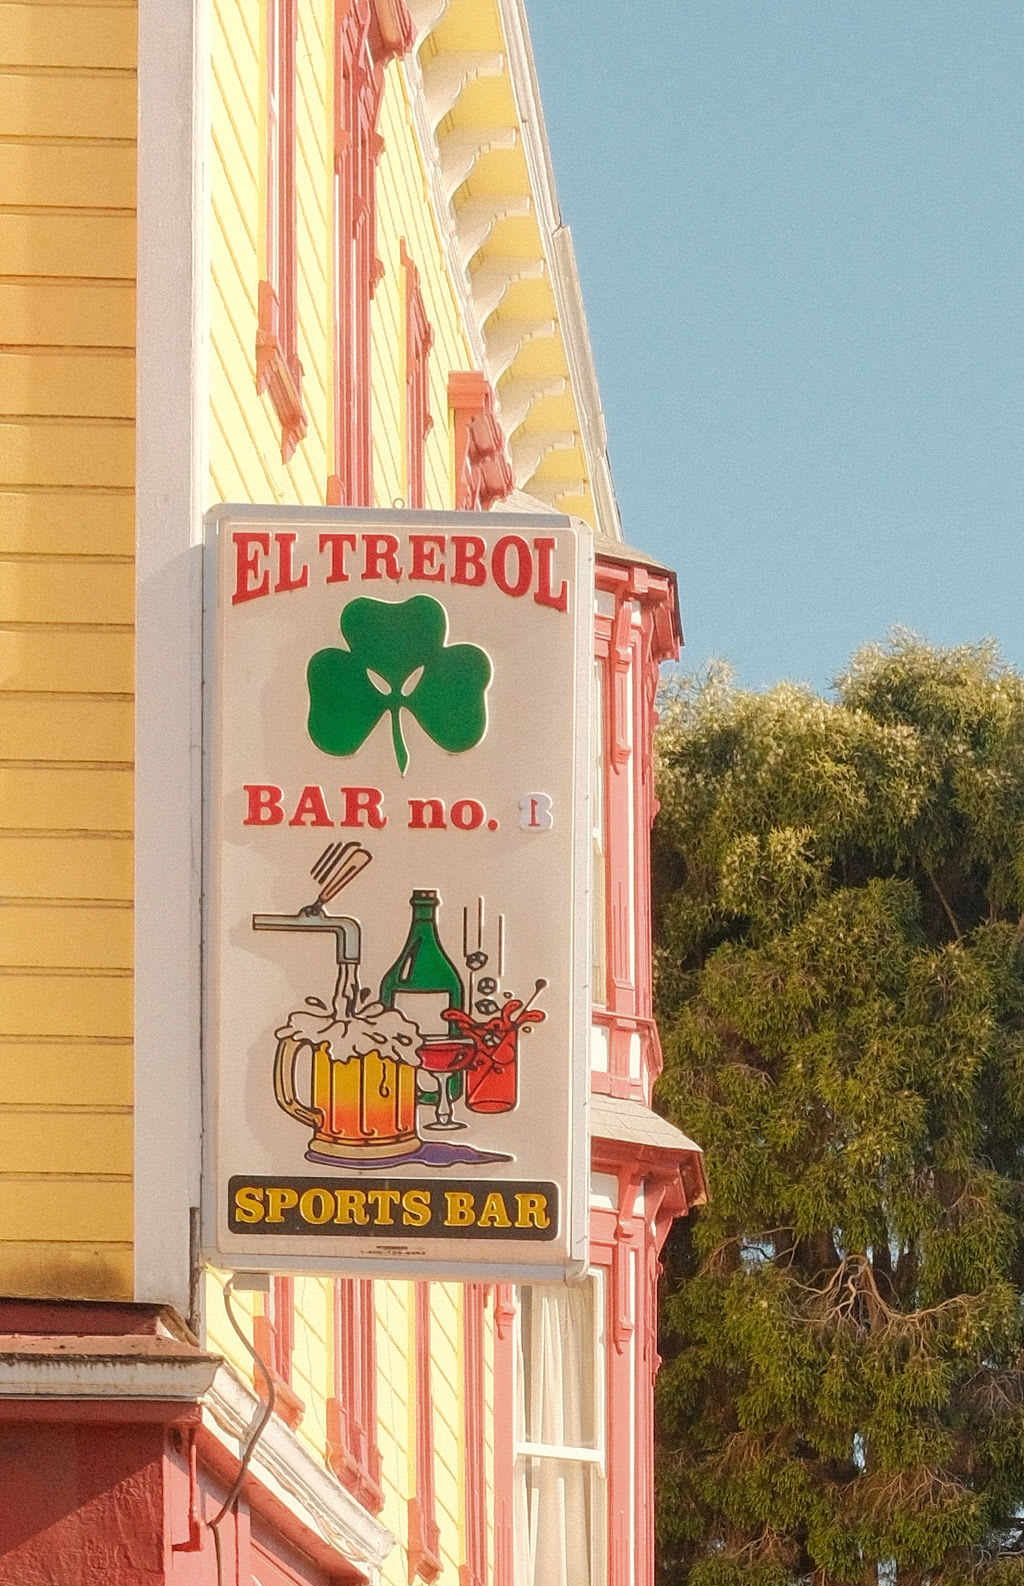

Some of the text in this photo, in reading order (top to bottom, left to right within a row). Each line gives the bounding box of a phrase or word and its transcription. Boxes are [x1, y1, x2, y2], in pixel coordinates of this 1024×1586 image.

[231, 532, 569, 613] EL TREBOL
[242, 784, 388, 829] BAR
[407, 799, 500, 832] no.
[234, 1186, 551, 1229] SPORTS BAR
